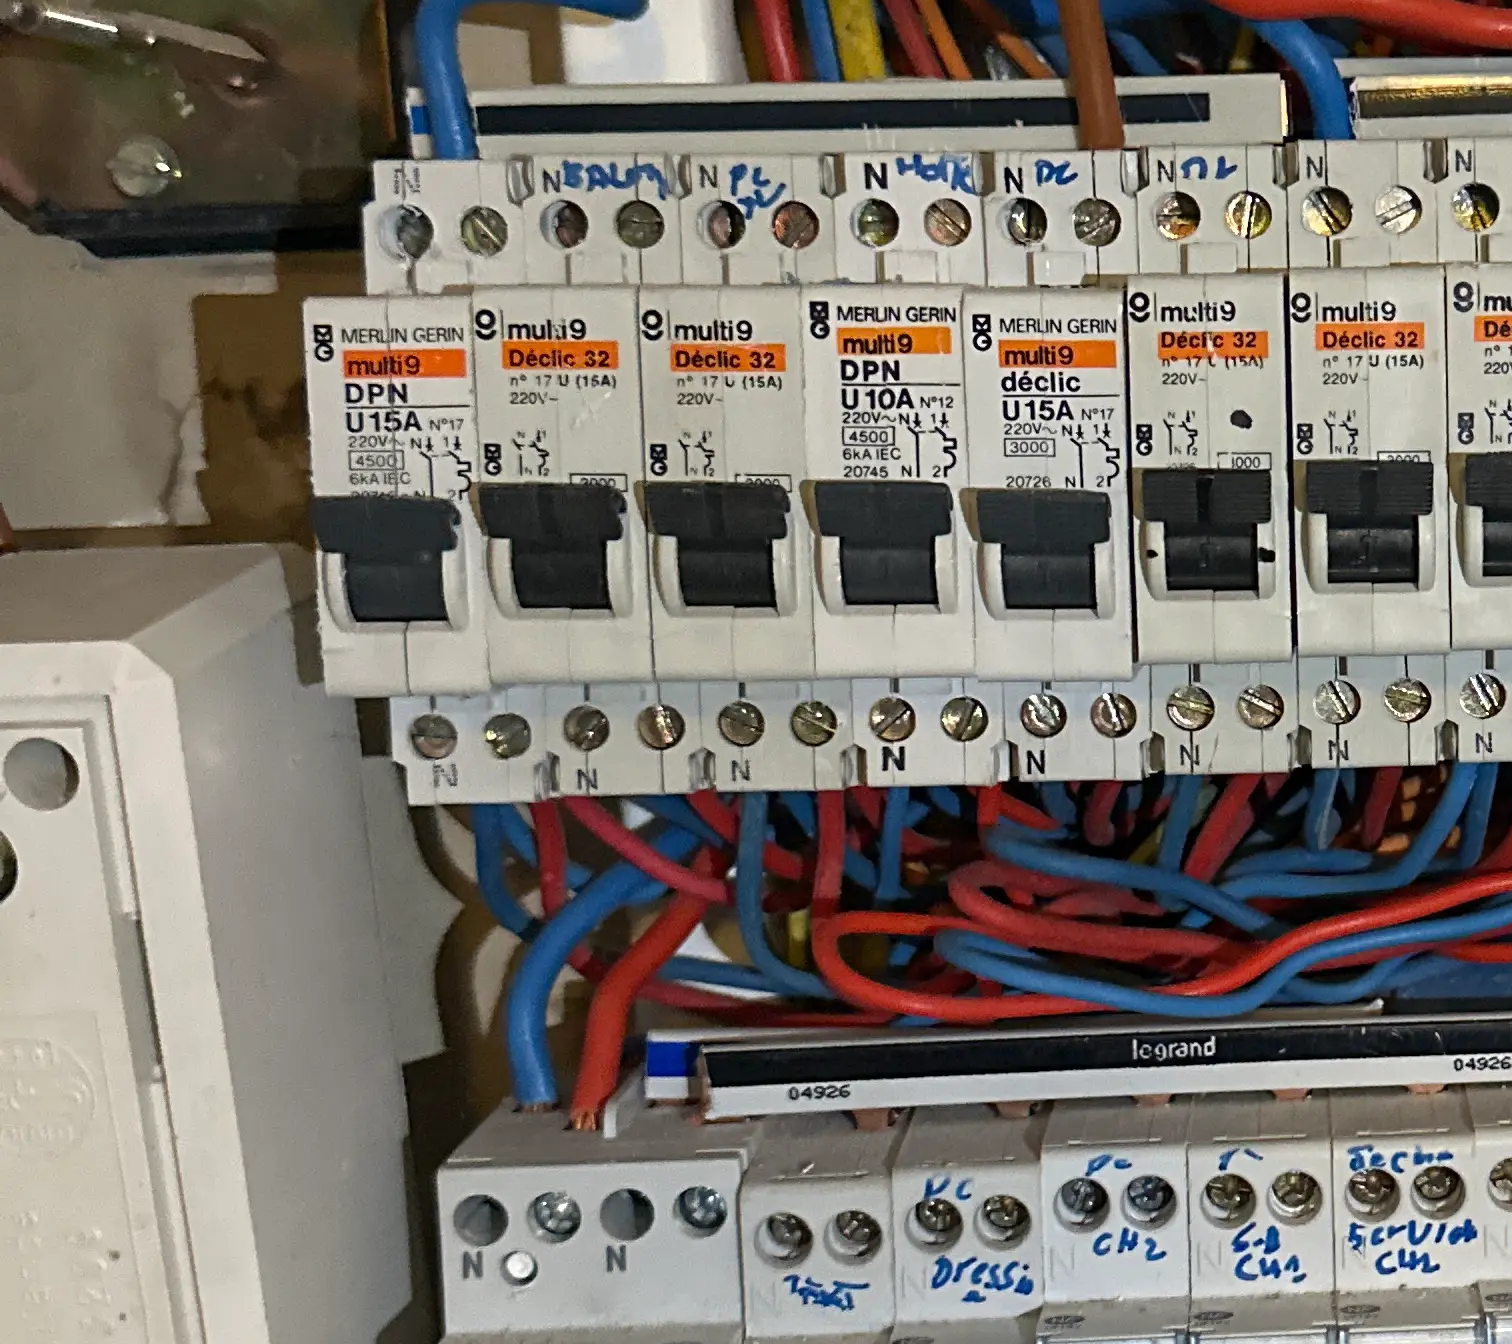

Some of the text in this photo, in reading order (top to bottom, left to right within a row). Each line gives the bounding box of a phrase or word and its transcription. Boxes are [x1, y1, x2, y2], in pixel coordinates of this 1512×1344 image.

[837, 306, 957, 322] MERLIN GERIN
[999, 318, 1117, 333] MERLIN GERIN
[341, 326, 464, 344] MERLIN GERIN
[1160, 331, 1257, 349] Déclic 32
[1322, 332, 1418, 349] Déclic 32
[509, 348, 611, 368] Déclic 32
[674, 349, 776, 369] Déclic 32
[1346, 354, 1425, 371] 17 U (15A)
[839, 360, 901, 381] DPN
[534, 374, 617, 389] 17 (15A)
[741, 376, 783, 391] (15A)
[1001, 371, 1081, 392] déclic
[345, 382, 408, 405] DPN
[848, 430, 889, 444] 4500
[871, 446, 901, 461] IEC
[1009, 441, 1049, 455] 3000
[843, 465, 889, 478] 20745
[1005, 475, 1051, 489] 20726
[1131, 1035, 1217, 1064] legrand
[1453, 1056, 1512, 1073] 04926
[787, 1083, 851, 1102] 04926
[461, 1252, 484, 1278] N
[606, 1248, 628, 1272] N
